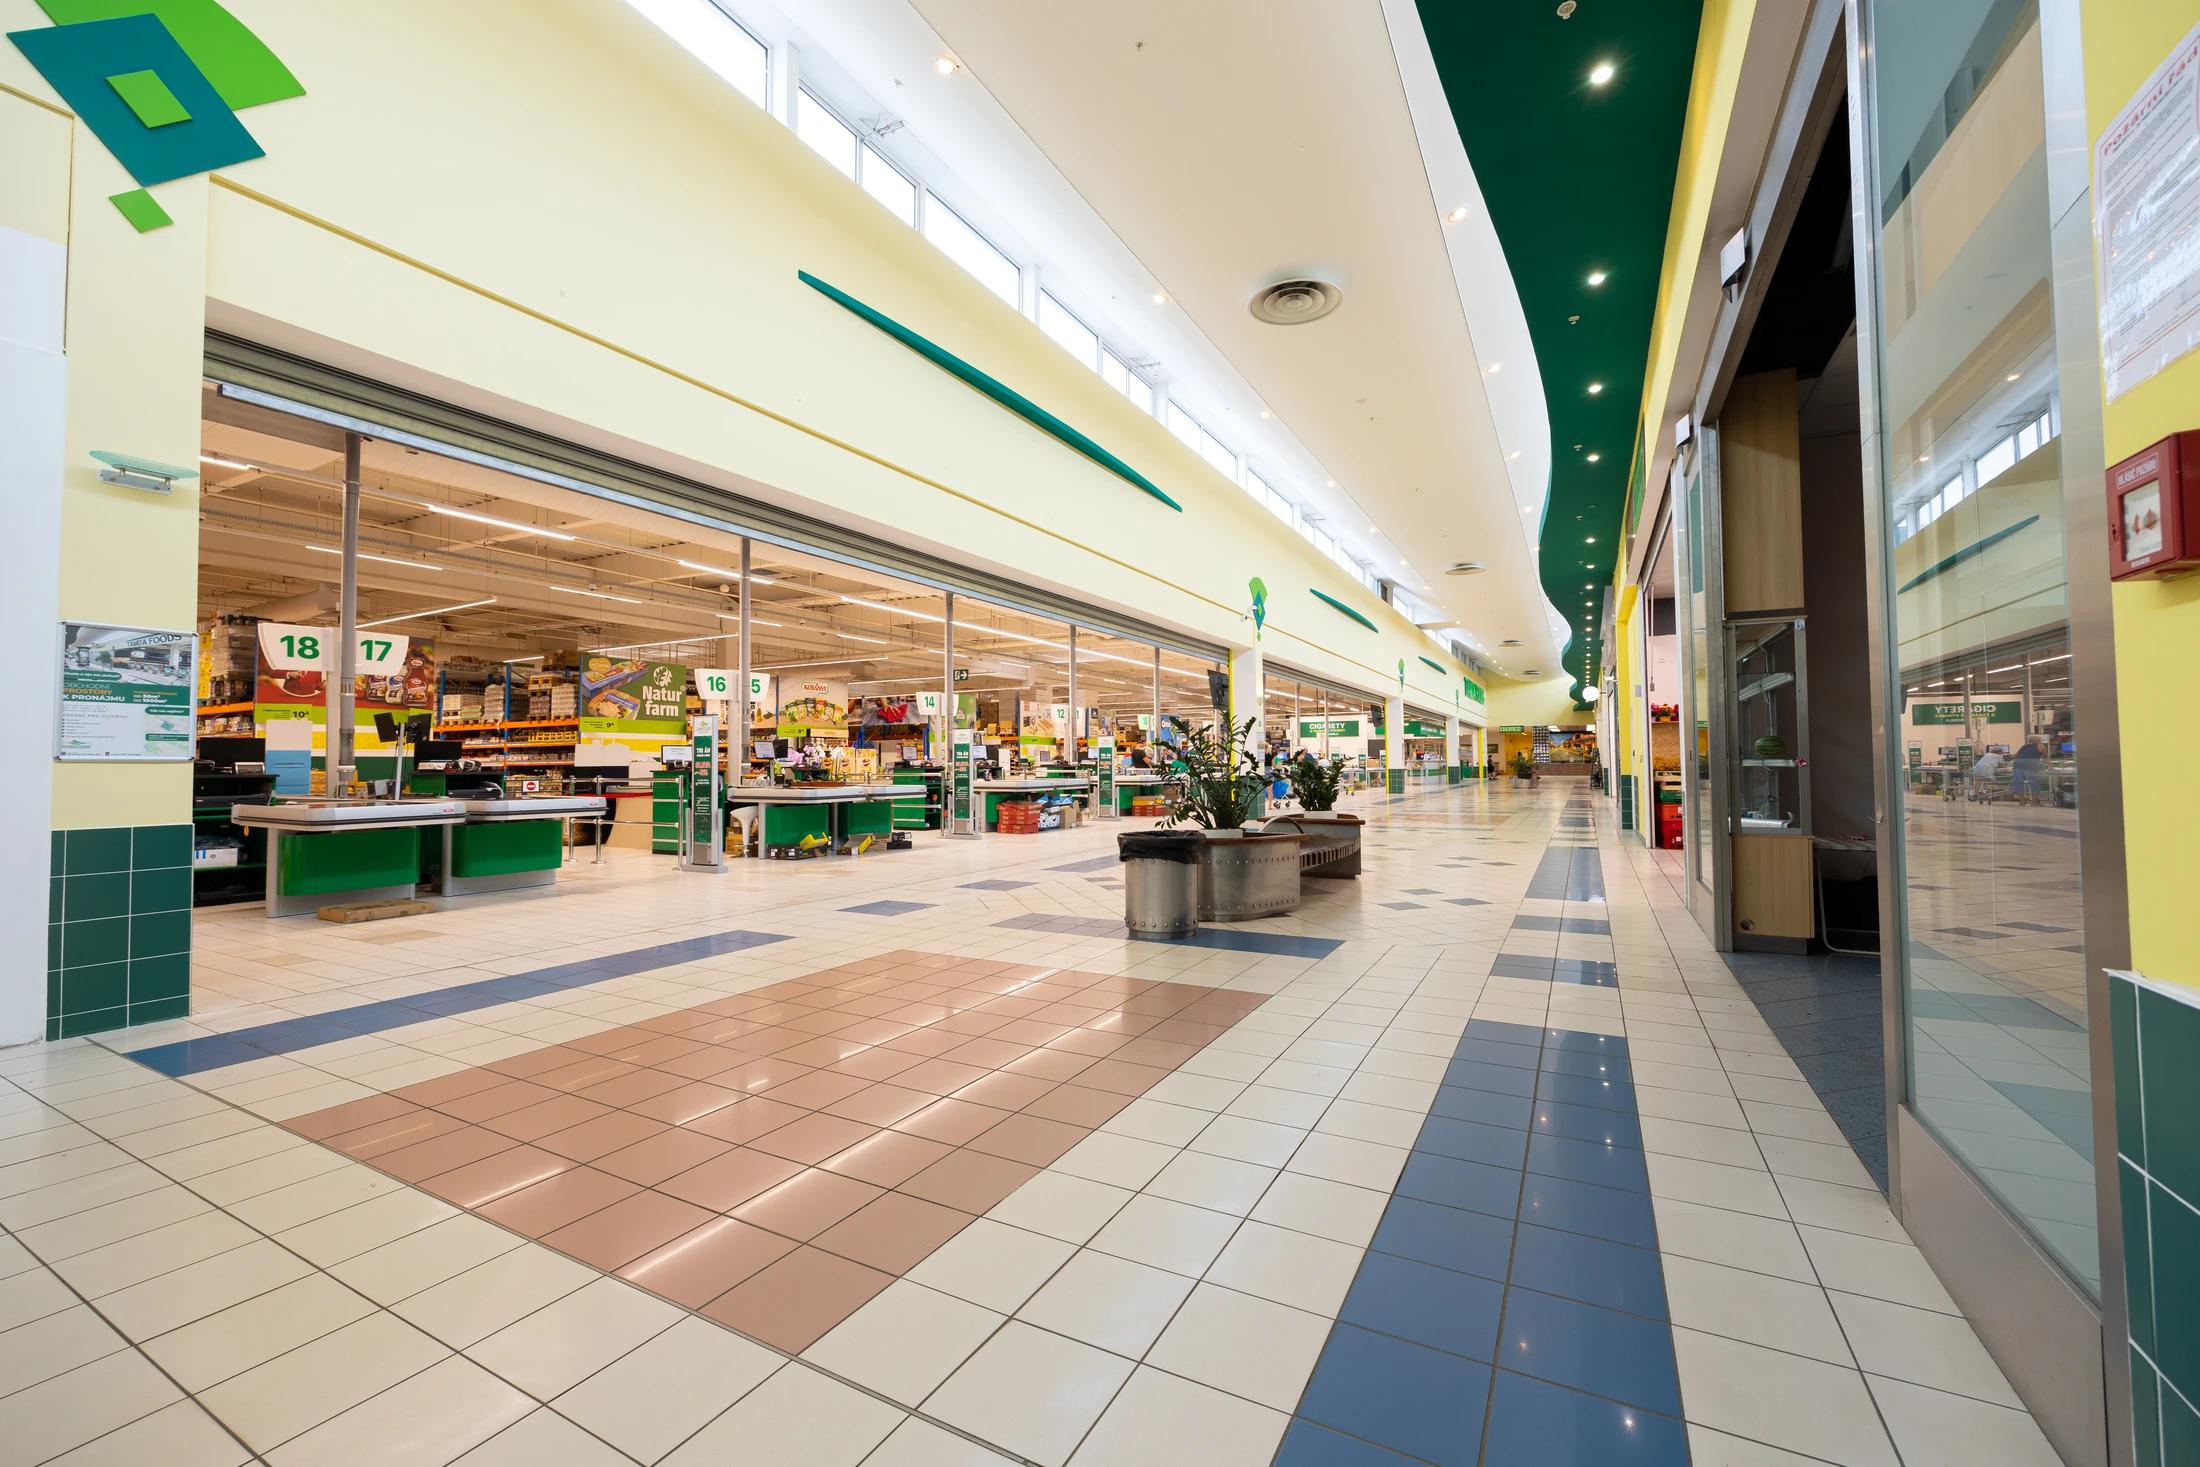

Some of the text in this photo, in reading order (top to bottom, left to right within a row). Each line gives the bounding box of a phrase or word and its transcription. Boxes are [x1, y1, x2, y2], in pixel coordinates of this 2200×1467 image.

[2104, 84, 2163, 157] Požární
[148, 633, 182, 644] FOODS
[280, 635, 320, 660] 18
[360, 639, 393, 662] 17
[706, 675, 726, 692] 16
[751, 678, 761, 694] 5
[71, 693, 126, 702] PRONÁJMU
[642, 685, 682, 702] Natur
[924, 696, 935, 708] 14
[645, 700, 679, 717] farm
[1057, 708, 1065, 719] 12
